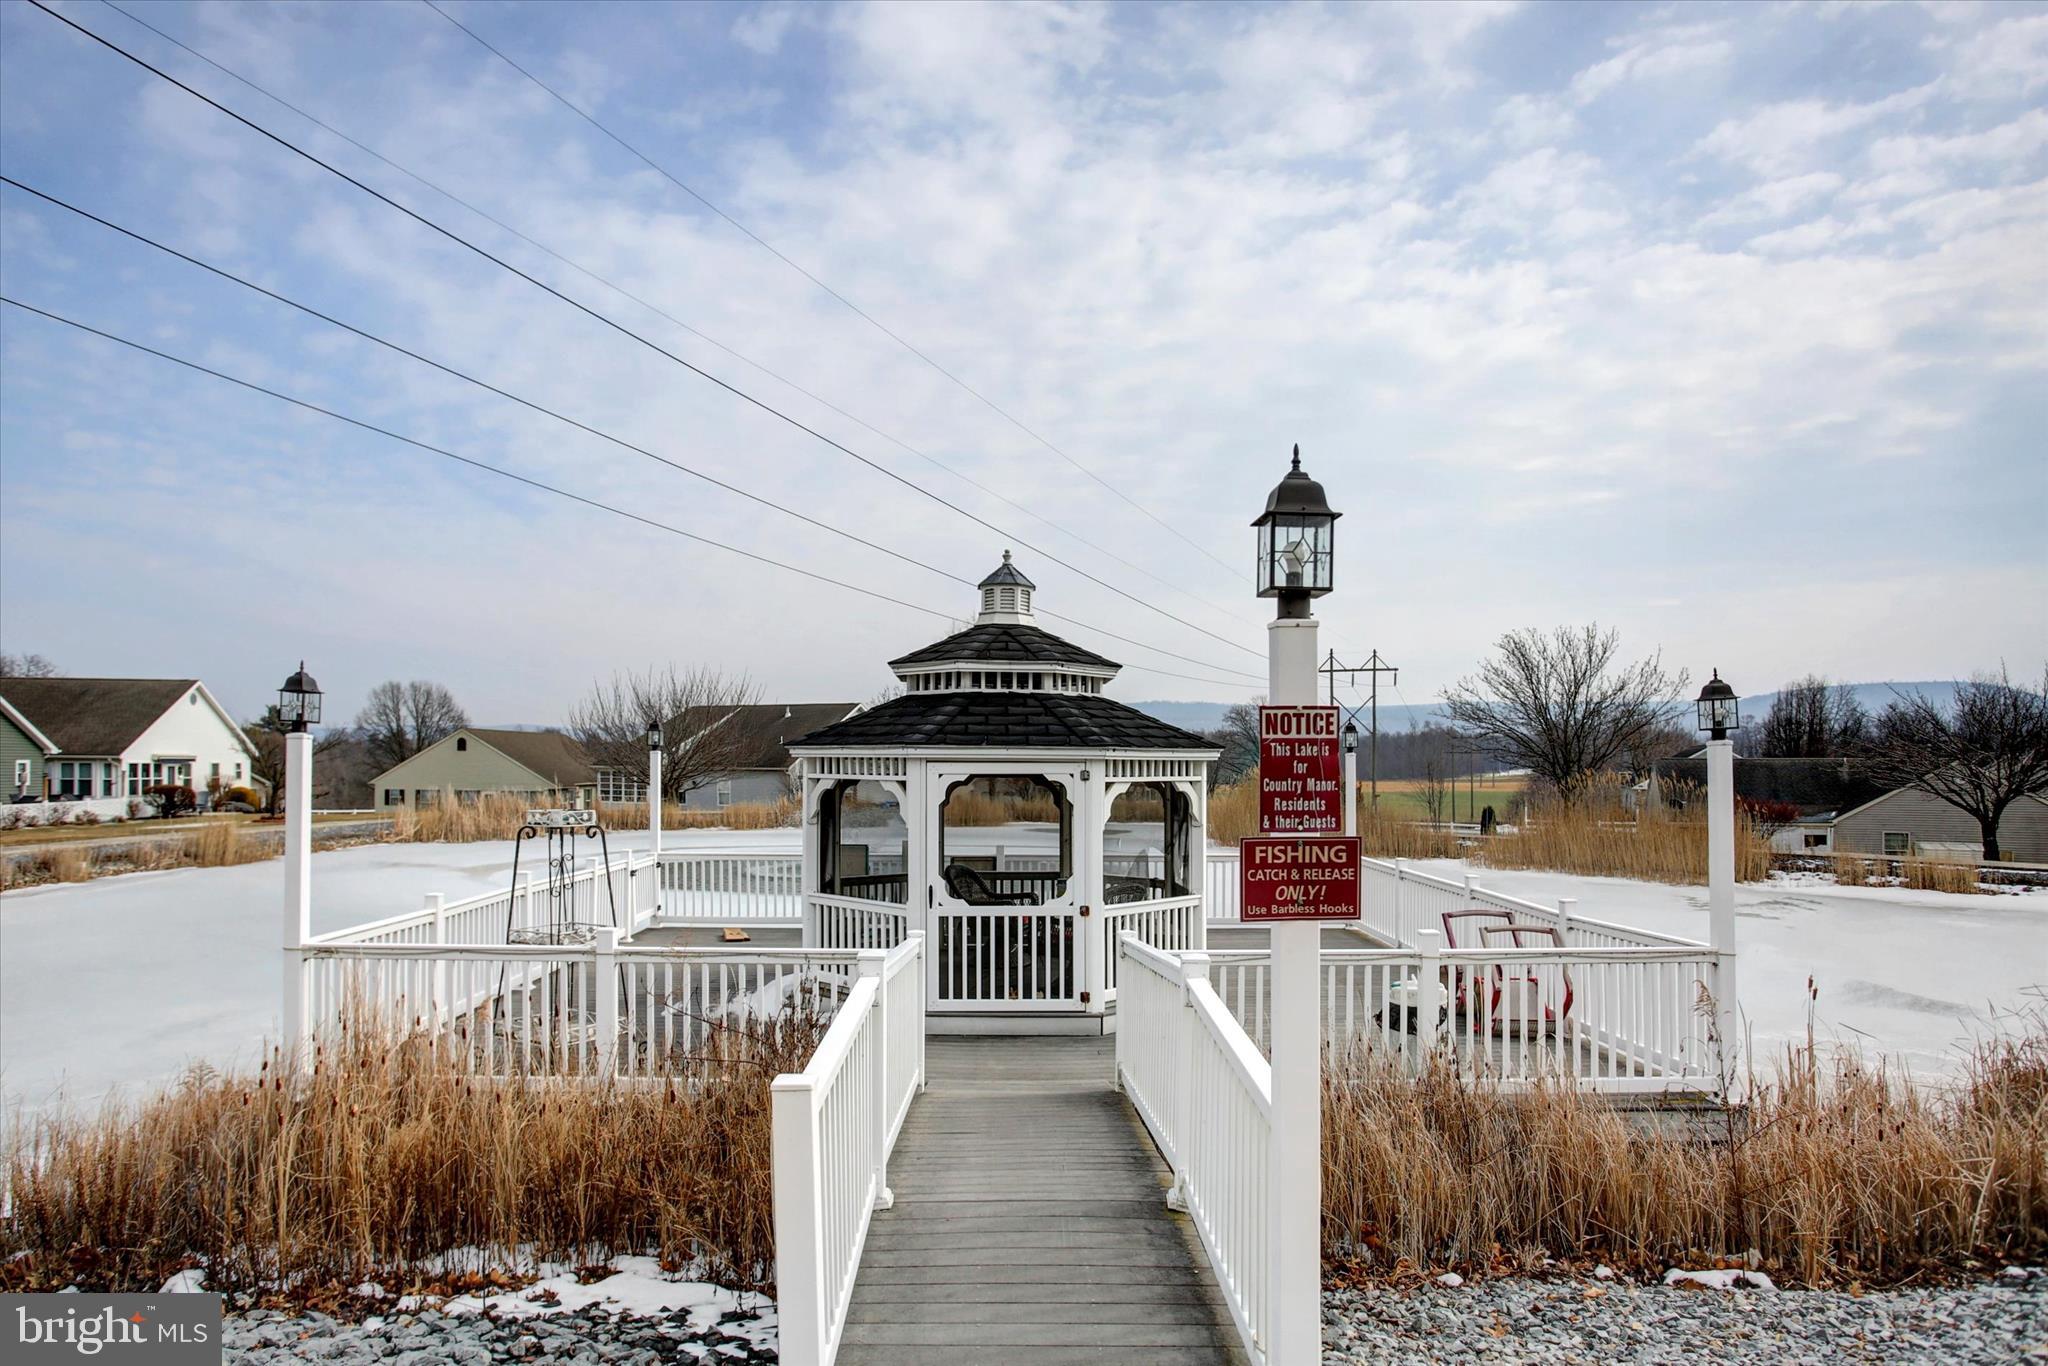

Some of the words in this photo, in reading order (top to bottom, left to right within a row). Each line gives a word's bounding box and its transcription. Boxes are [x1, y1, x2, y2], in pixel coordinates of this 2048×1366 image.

[1265, 712, 1335, 736] NOTICE
[1270, 742, 1290, 756] This
[1295, 742, 1319, 756] Lake
[1321, 742, 1329, 756] is
[1293, 760, 1308, 774] for
[1263, 778, 1302, 794] Country
[1274, 797, 1326, 811] Residents
[1263, 815, 1270, 828] &
[1275, 815, 1299, 828] their
[1303, 815, 1336, 828] Guests
[1255, 845, 1347, 864] FISHING
[1247, 869, 1287, 881] CATCH
[1291, 869, 1300, 880] &
[1303, 868, 1355, 880] RELEASE
[1275, 885, 1327, 900] ONLY!
[1247, 905, 1267, 915] Use
[1271, 903, 1315, 914] Barbless
[1320, 903, 1354, 913] Hooks
